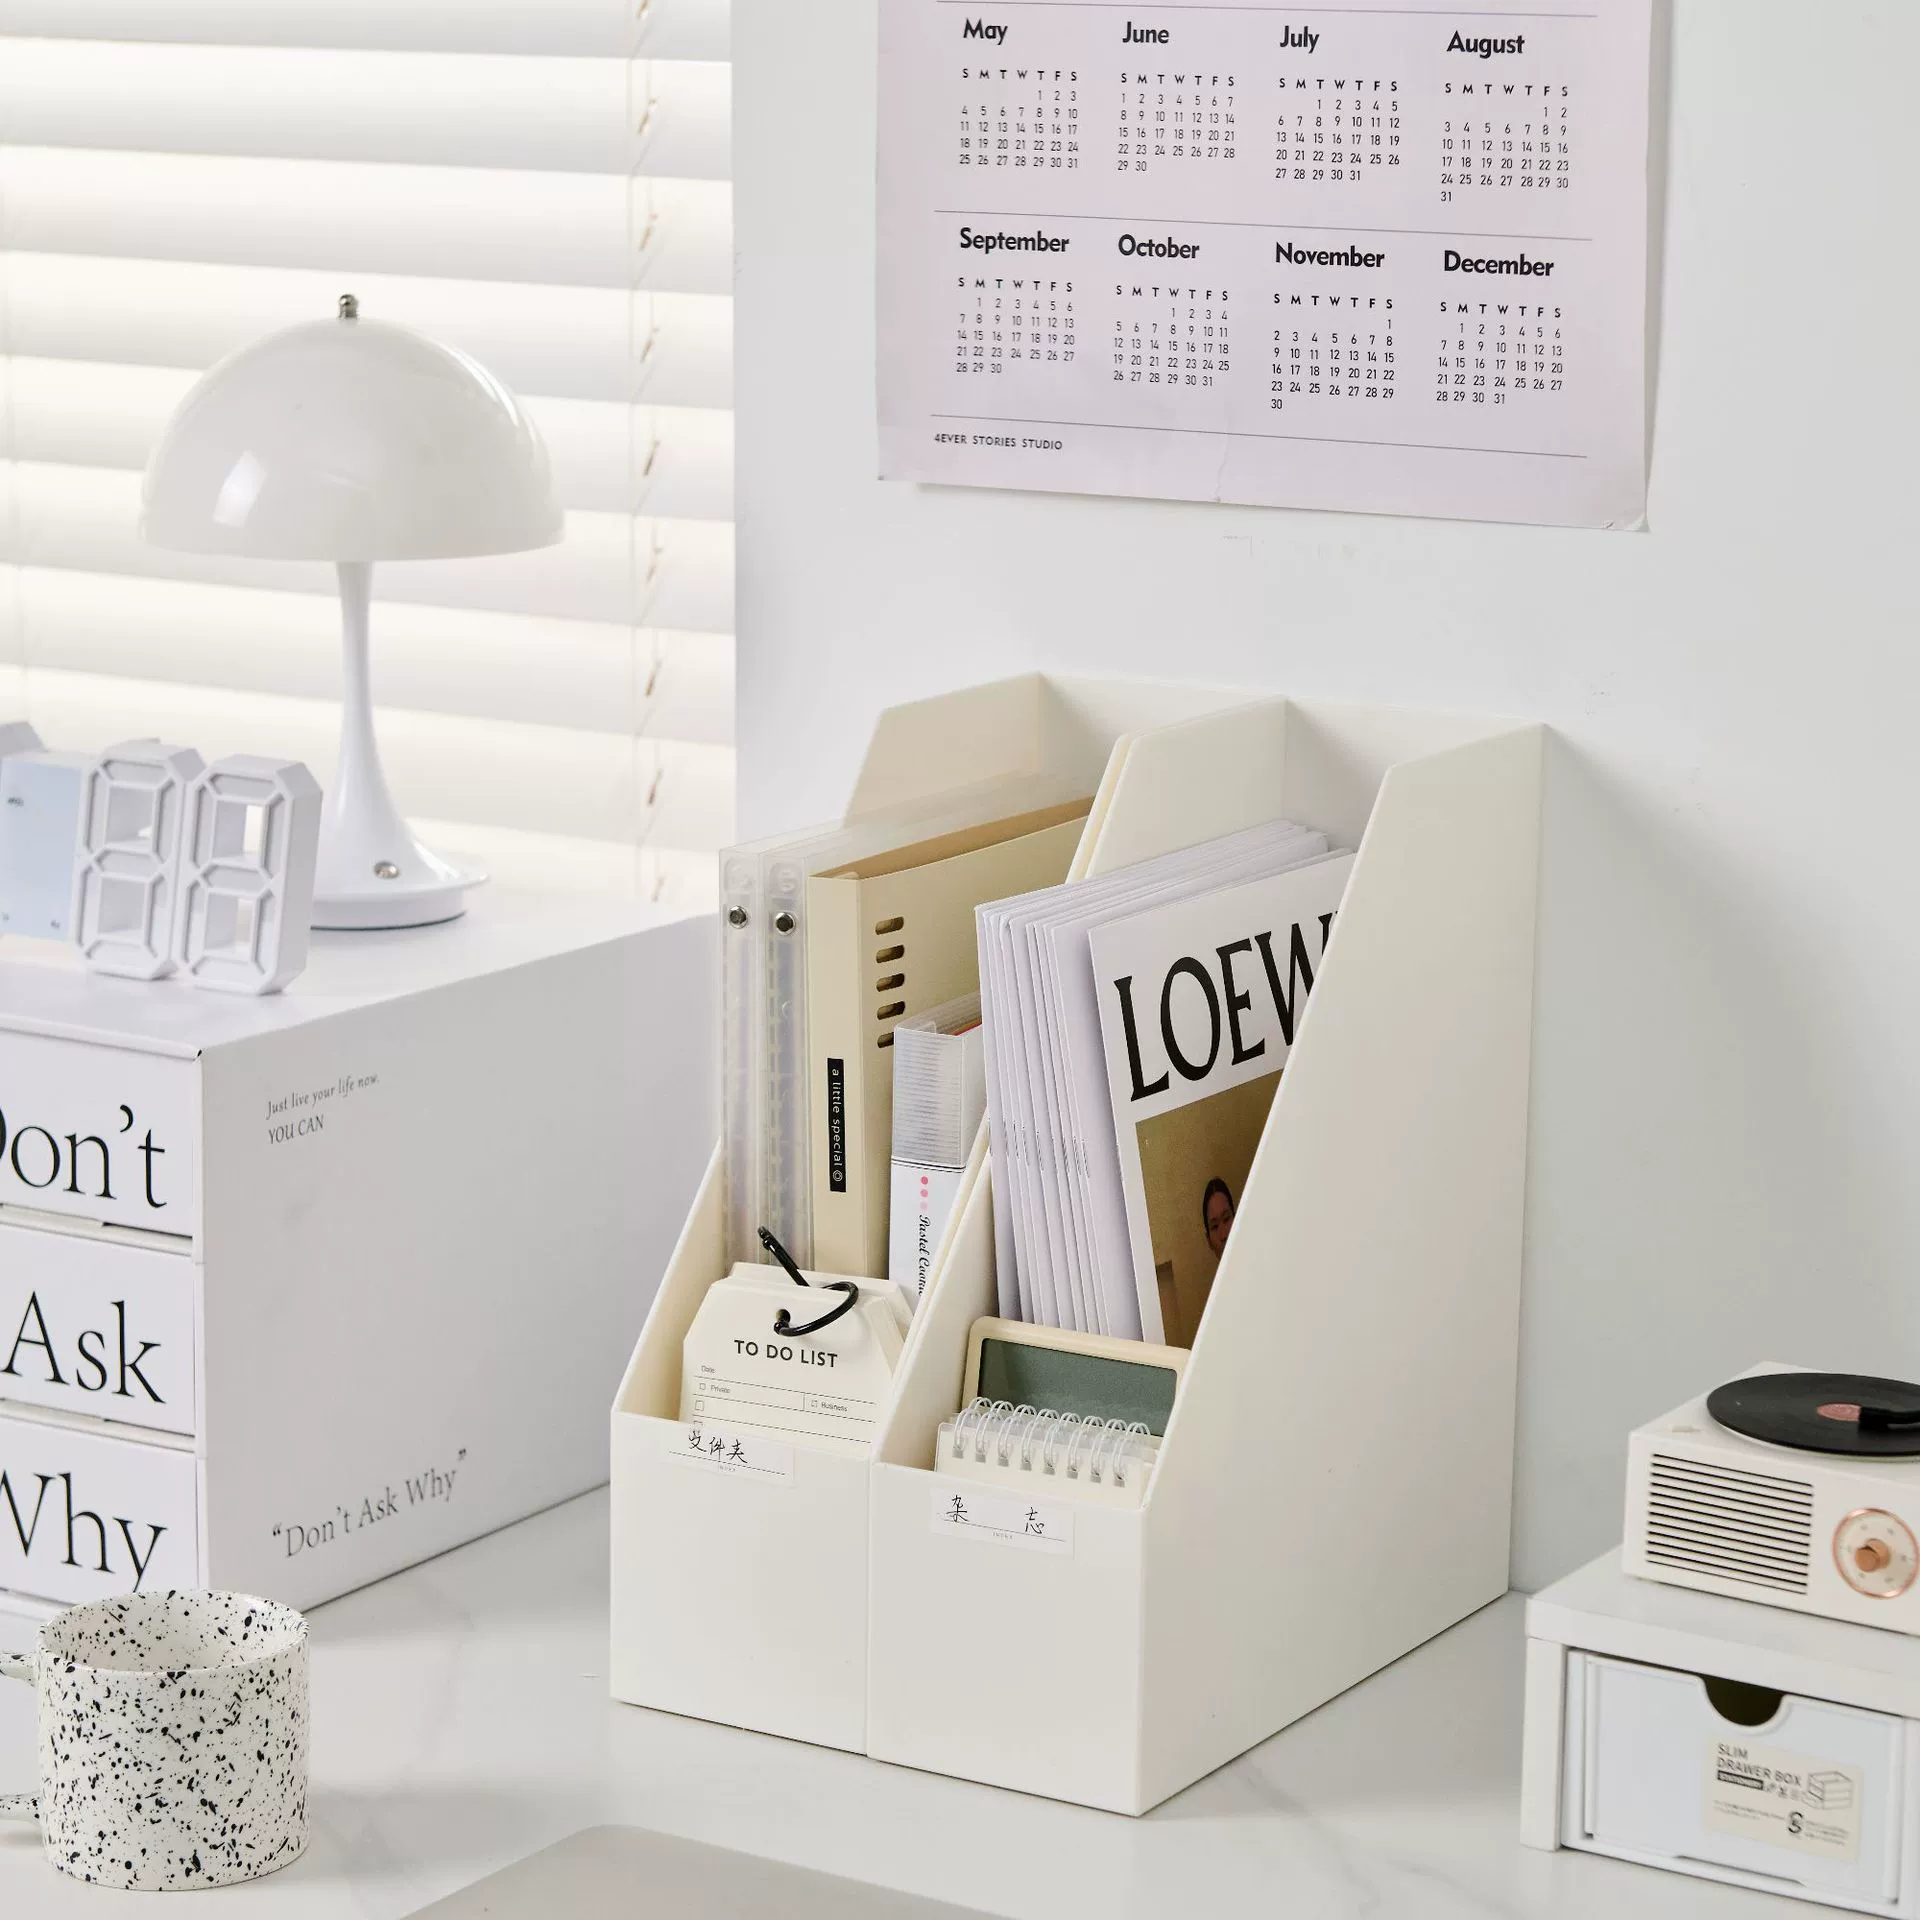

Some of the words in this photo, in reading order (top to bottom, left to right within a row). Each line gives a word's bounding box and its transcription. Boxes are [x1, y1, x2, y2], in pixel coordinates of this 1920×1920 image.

[962, 17, 1009, 46] May
[1121, 20, 1170, 45] June
[1279, 25, 1320, 55] July
[1445, 29, 1526, 60] August
[1279, 77, 1286, 89] S
[1295, 78, 1307, 90] M
[1316, 78, 1325, 90] T
[1333, 79, 1346, 90] W
[1354, 79, 1364, 92] T
[1373, 80, 1381, 92] F
[1390, 80, 1398, 92] S
[1444, 82, 1452, 94] S
[1462, 83, 1474, 95] M
[1484, 83, 1493, 95] T
[1503, 84, 1515, 95] W
[1524, 84, 1534, 96] T
[1543, 85, 1551, 97] F
[1561, 85, 1568, 97] S
[1276, 131, 1287, 143] 13
[1295, 132, 1305, 143] 14
[1313, 132, 1324, 144] 15
[1332, 133, 1342, 145] 16
[1351, 133, 1362, 145] 17
[1370, 134, 1381, 146] 18
[1389, 135, 1400, 146] 19
[959, 153, 971, 165] 25
[977, 154, 989, 166] 26
[996, 154, 1009, 166] 27
[1014, 155, 1027, 167] 28
[1032, 156, 1045, 167] 29
[1050, 156, 1062, 168] 30
[1067, 157, 1078, 169] 31
[1117, 143, 1129, 155] 22
[1135, 144, 1147, 156] 23
[1154, 144, 1166, 156] 24
[1172, 145, 1184, 157] 25
[1190, 146, 1202, 158] 26
[1207, 146, 1219, 158] 27
[1223, 147, 1236, 159] 28
[1275, 148, 1288, 161] 20
[1294, 149, 1305, 161] 21
[1312, 150, 1324, 162] 22
[1331, 151, 1343, 164] 23
[1350, 152, 1362, 164] 24
[1369, 153, 1382, 165] 25
[1388, 153, 1400, 166] 26
[1442, 155, 1453, 167] 17
[1460, 156, 1472, 168] 18
[1481, 157, 1493, 169] 19
[1500, 157, 1513, 170] 20
[1520, 158, 1532, 170] 21
[1538, 159, 1552, 171] 22
[1556, 159, 1569, 172] 23
[1441, 172, 1454, 185] 24
[1459, 173, 1472, 185] 25
[1480, 174, 1493, 186] 26
[1500, 174, 1513, 187] 27
[1520, 175, 1534, 188] 28
[1538, 176, 1551, 188] 29
[1556, 176, 1569, 189] 30
[959, 226, 1070, 255] September
[1117, 233, 1201, 259] October
[1275, 241, 1386, 268] November
[1443, 249, 1555, 277] December
[1273, 293, 1281, 304] S
[1290, 294, 1302, 305] M
[1310, 295, 1320, 306] T
[1328, 295, 1341, 307] W
[1349, 296, 1359, 308] T
[1369, 297, 1376, 309] F
[1385, 298, 1393, 310] S
[1440, 301, 1447, 312] S
[1457, 303, 1469, 314] M
[1478, 303, 1488, 315] T
[1497, 304, 1509, 315] W
[1518, 305, 1528, 317] T
[1537, 306, 1545, 318] F
[1554, 307, 1561, 319] S
[956, 345, 967, 357] 21
[973, 345, 984, 357] 22
[991, 346, 1003, 358] 23
[1010, 347, 1022, 359] 24
[1029, 348, 1041, 360] 25
[1047, 349, 1058, 361] 26
[1063, 350, 1075, 362] 27
[1113, 353, 1124, 364] 19
[1130, 354, 1142, 366] 20
[1149, 355, 1159, 367] 21
[1167, 357, 1179, 369] 22
[1185, 358, 1197, 370] 23
[1202, 359, 1214, 370] 24
[1218, 360, 1230, 372] 25
[1271, 363, 1282, 375] 16
[1290, 364, 1301, 376] 17
[1309, 365, 1320, 377] 18
[1330, 366, 1341, 377] 19
[1348, 367, 1361, 379] 20
[1366, 368, 1377, 380] 21
[1383, 369, 1395, 381] 22
[1437, 373, 1448, 385] 21
[1453, 373, 1466, 385] 22
[1472, 374, 1486, 387] 23
[1494, 376, 1506, 388] 24
[1514, 377, 1527, 389] 25
[1533, 378, 1545, 390] 26
[1550, 379, 1563, 391] 27
[1271, 380, 1283, 392] 23
[1289, 381, 1301, 393] 24
[1308, 382, 1321, 394] 25
[1328, 384, 1341, 396] 26
[1348, 385, 1360, 397] 27
[1365, 386, 1378, 399] 28
[1382, 387, 1394, 399] 29
[934, 433, 967, 445] 4EVER
[972, 435, 1017, 448] STORIES
[1021, 438, 1063, 451] STUDIO
[1113, 910, 1339, 1102] LOEW
[831, 1068, 840, 1076] a
[265, 1097, 288, 1120] Just
[291, 1091, 309, 1108] live
[311, 1087, 335, 1108] your
[338, 1075, 355, 1098] life
[831, 1081, 841, 1114] little
[268, 1123, 294, 1145] YOU
[297, 1113, 325, 1136] CAN
[832, 1118, 843, 1167] special
[0, 1105, 167, 1209] on’t
[918, 1214, 931, 1255] Pastel
[0, 1290, 167, 1404] Ask
[734, 1339, 759, 1356] TO
[766, 1344, 793, 1361] DO
[800, 1349, 838, 1368] LIST
[358, 1486, 398, 1528] Ask
[1717, 1743, 1749, 1759] SLIM
[1716, 1757, 1773, 1780] DRAWER
[1775, 1771, 1802, 1787] BOX
[1788, 1811, 1804, 1834] S
